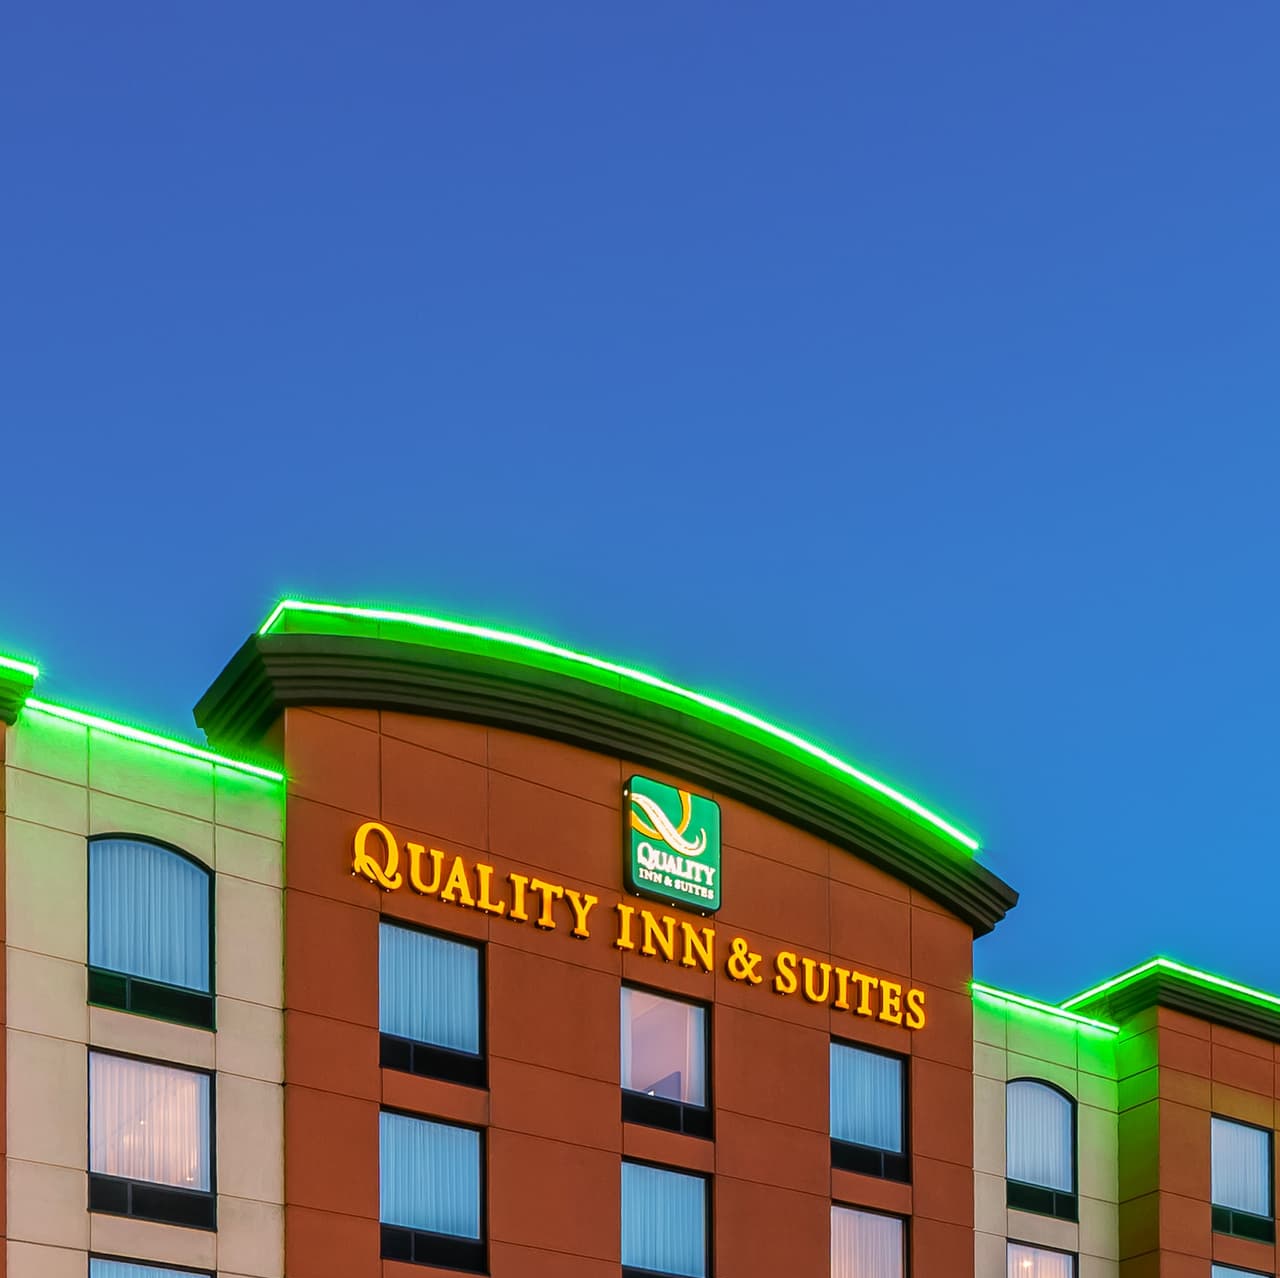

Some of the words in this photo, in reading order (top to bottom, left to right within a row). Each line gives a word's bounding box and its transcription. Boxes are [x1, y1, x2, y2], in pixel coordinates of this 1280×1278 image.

[637, 842, 716, 887] QUALITY
[638, 867, 663, 884] INN
[664, 875, 673, 888] &
[674, 879, 715, 900] SUITES
[353, 821, 599, 938] QUALITY
[616, 902, 715, 971] INN
[727, 937, 763, 985] &
[775, 951, 926, 1030] SUITES
